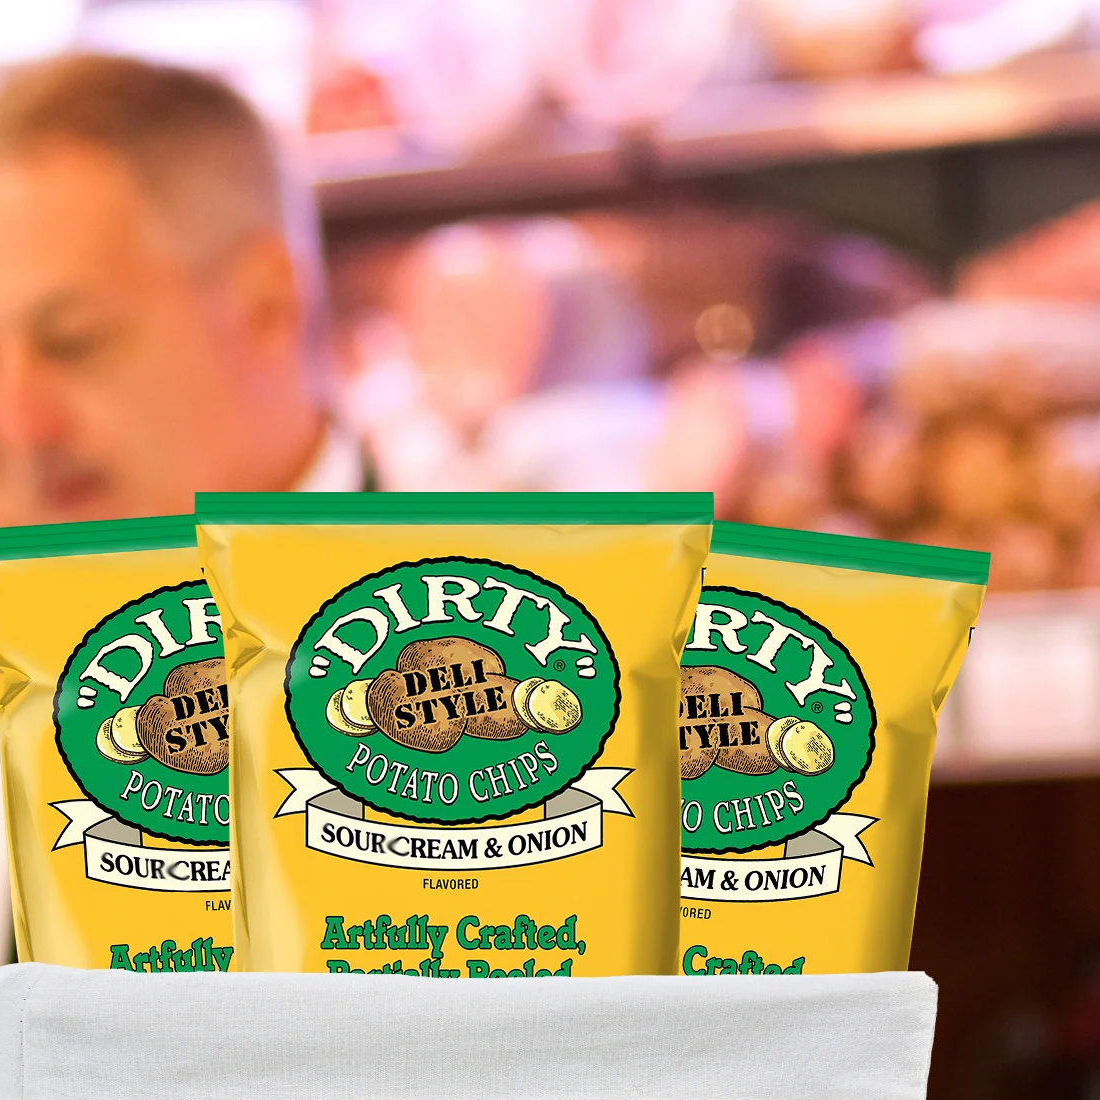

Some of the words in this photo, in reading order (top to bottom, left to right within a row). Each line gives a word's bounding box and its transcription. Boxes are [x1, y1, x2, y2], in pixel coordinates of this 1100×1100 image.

[402, 658, 488, 700] DELI
[170, 684, 229, 722] DE
[396, 686, 508, 729] STYLE
[679, 692, 744, 719] ELI
[165, 714, 229, 754] STY
[679, 721, 761, 750] TYLE
[346, 742, 459, 805] POTATO
[468, 741, 559, 803] CHIPS
[120, 770, 230, 826] POTATO
[712, 779, 804, 835] CHIPS
[321, 823, 386, 854] SOUR
[387, 836, 479, 860] CREAM
[484, 840, 503, 858] &
[508, 821, 588, 855] ONION
[100, 852, 166, 880] SOUR
[167, 860, 231, 882] CREA
[423, 878, 479, 890] FLAVORED
[720, 870, 739, 891] &
[744, 864, 827, 891] ONION
[205, 900, 231, 911] FLAV
[680, 906, 712, 920] ORED
[321, 914, 448, 958] Artfully
[456, 914, 586, 955] Crafted,
[110, 937, 234, 974] Artfully
